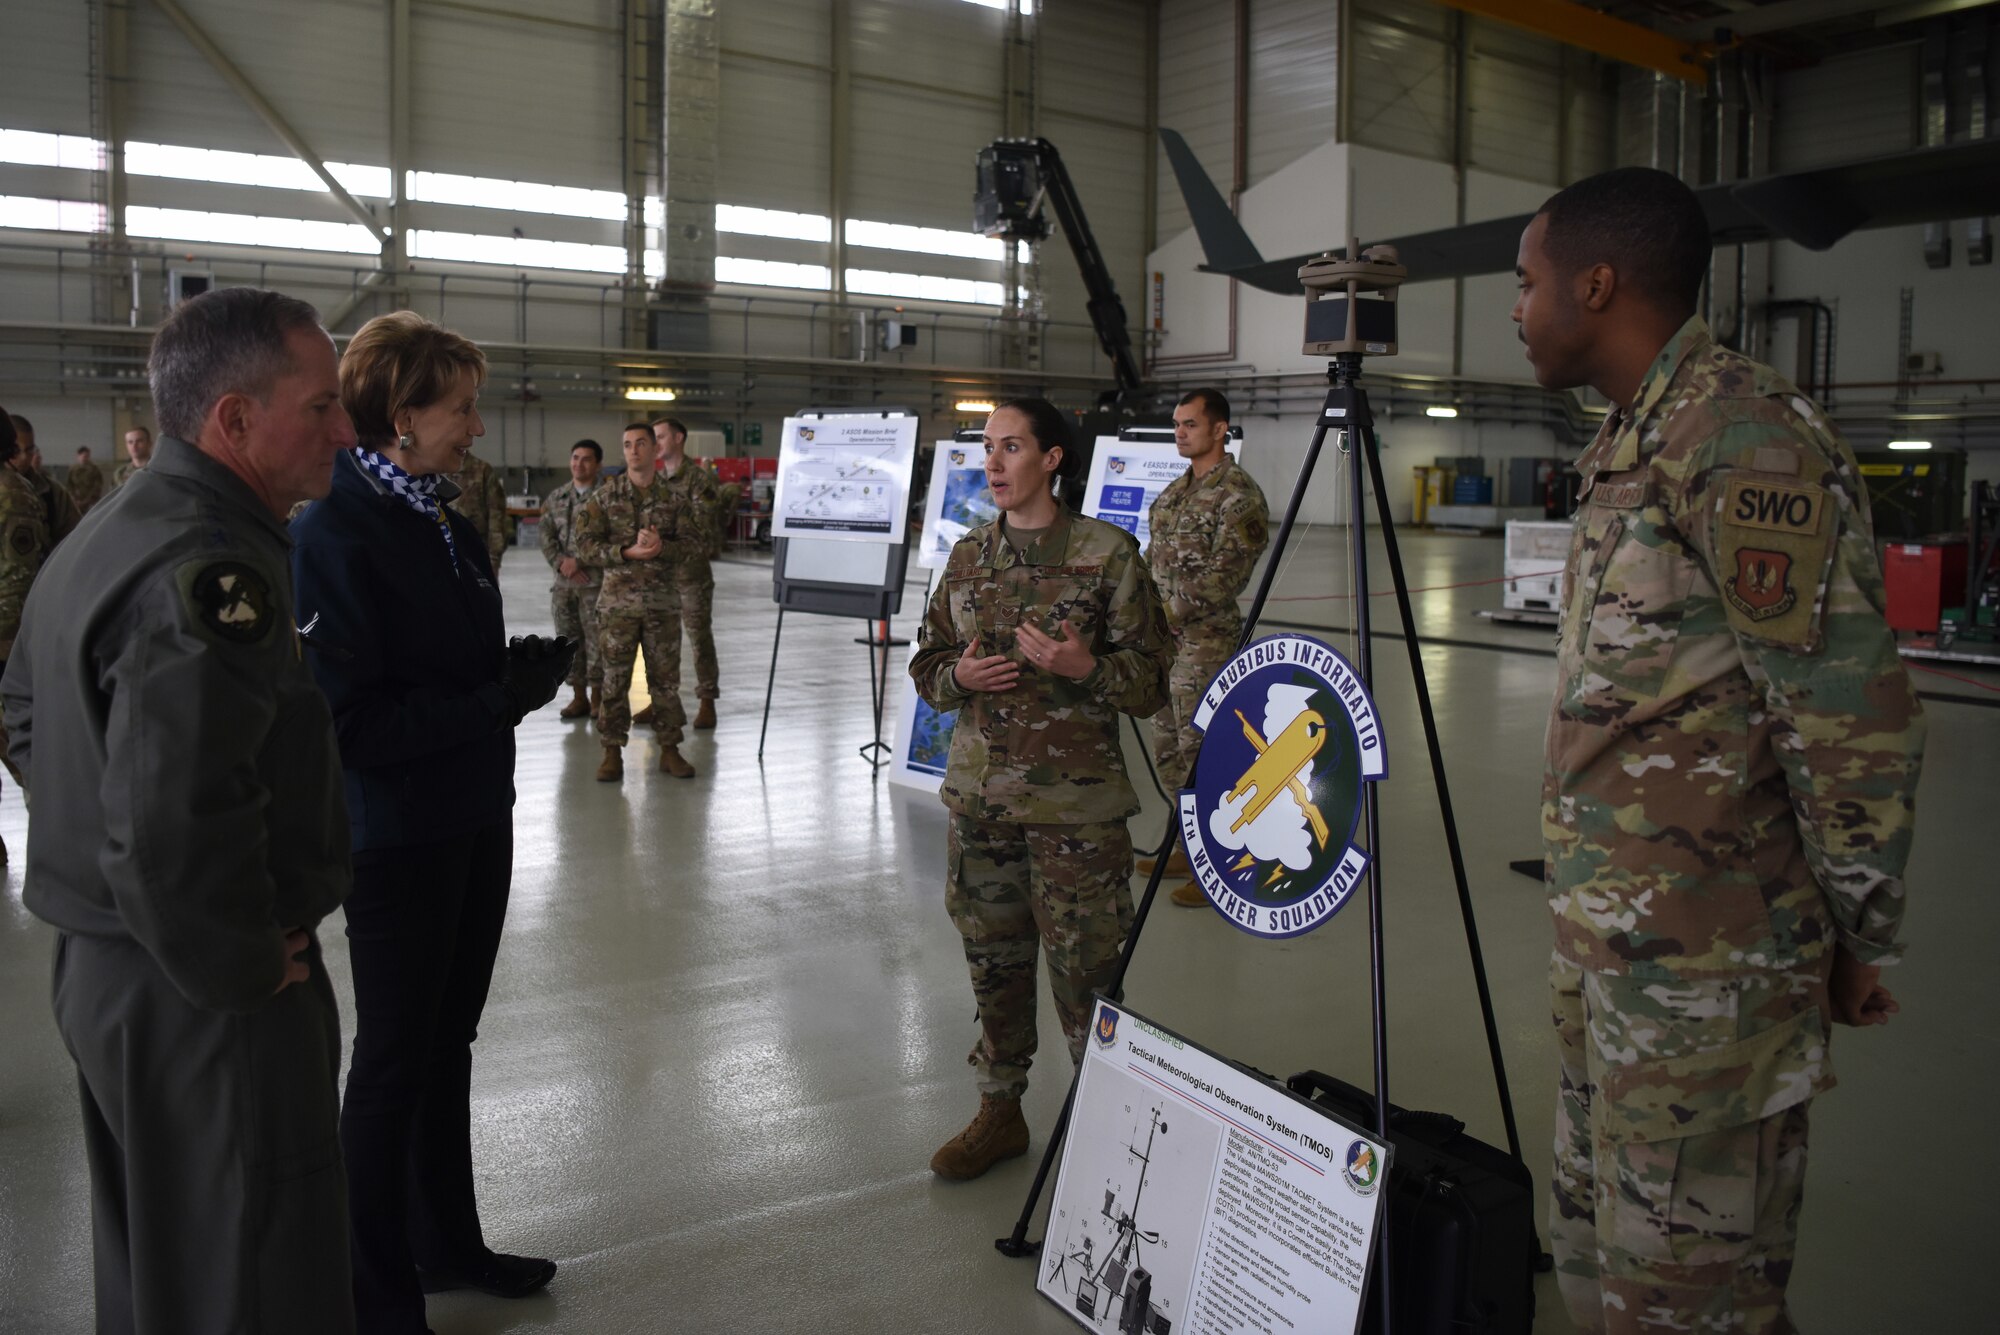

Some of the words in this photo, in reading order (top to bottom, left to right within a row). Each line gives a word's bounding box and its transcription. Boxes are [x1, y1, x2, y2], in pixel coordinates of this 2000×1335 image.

[1736, 488, 1812, 526] SWO
[1206, 694, 1218, 710] E
[1221, 641, 1286, 694] NUBIBUS
[1294, 642, 1377, 751] INFORMATIO
[1183, 805, 1195, 840] 7TH
[1194, 848, 1256, 926] WEATHER
[1269, 858, 1358, 931] SQUADRON
[1134, 1018, 1184, 1050] UNCLASSIFIED
[1124, 1103, 1130, 1114] 10
[1127, 1040, 1155, 1063] Tactical
[1156, 1055, 1213, 1095] Meteorological
[1214, 1086, 1264, 1122] Observation
[1265, 1114, 1297, 1141] System
[1299, 1133, 1334, 1163] (TMOS)
[1227, 1136, 1244, 1152] Model:
[1229, 1126, 1264, 1152] Manufacturer:
[1267, 1148, 1286, 1165] Vaisala
[1213, 1205, 1227, 1221] (BIT)
[1226, 1146, 1236, 1158] The
[1236, 1153, 1256, 1170] Vaisala
[1256, 1165, 1290, 1190] MAWS201M
[1290, 1185, 1315, 1206] TACMET
[1316, 1200, 1337, 1219] System
[1253, 1176, 1276, 1194] compact
[1277, 1190, 1298, 1207] weather
[1299, 1204, 1317, 1219] station
[1327, 1221, 1348, 1238] various
[1349, 1232, 1362, 1246] field
[1215, 1195, 1235, 1215] (COTS)
[1236, 1210, 1256, 1226] product
[1256, 1223, 1267, 1234] and
[1268, 1228, 1301, 1255] incorporates
[1302, 1252, 1324, 1270] efficient
[1324, 1265, 1359, 1294] Built-In-Test
[1219, 1177, 1240, 1194] portable
[1241, 1189, 1274, 1215] MAWS201M
[1274, 1211, 1294, 1228] system
[1294, 1224, 1305, 1235] can
[1306, 1229, 1314, 1240] be
[1314, 1236, 1331, 1253] easily
[1332, 1248, 1343, 1259] and
[1344, 1255, 1364, 1274] rapidly
[1252, 1184, 1273, 1205] Offering
[1274, 1198, 1290, 1213] broad
[1291, 1210, 1309, 1225] sensor
[1339, 1238, 1348, 1250] the
